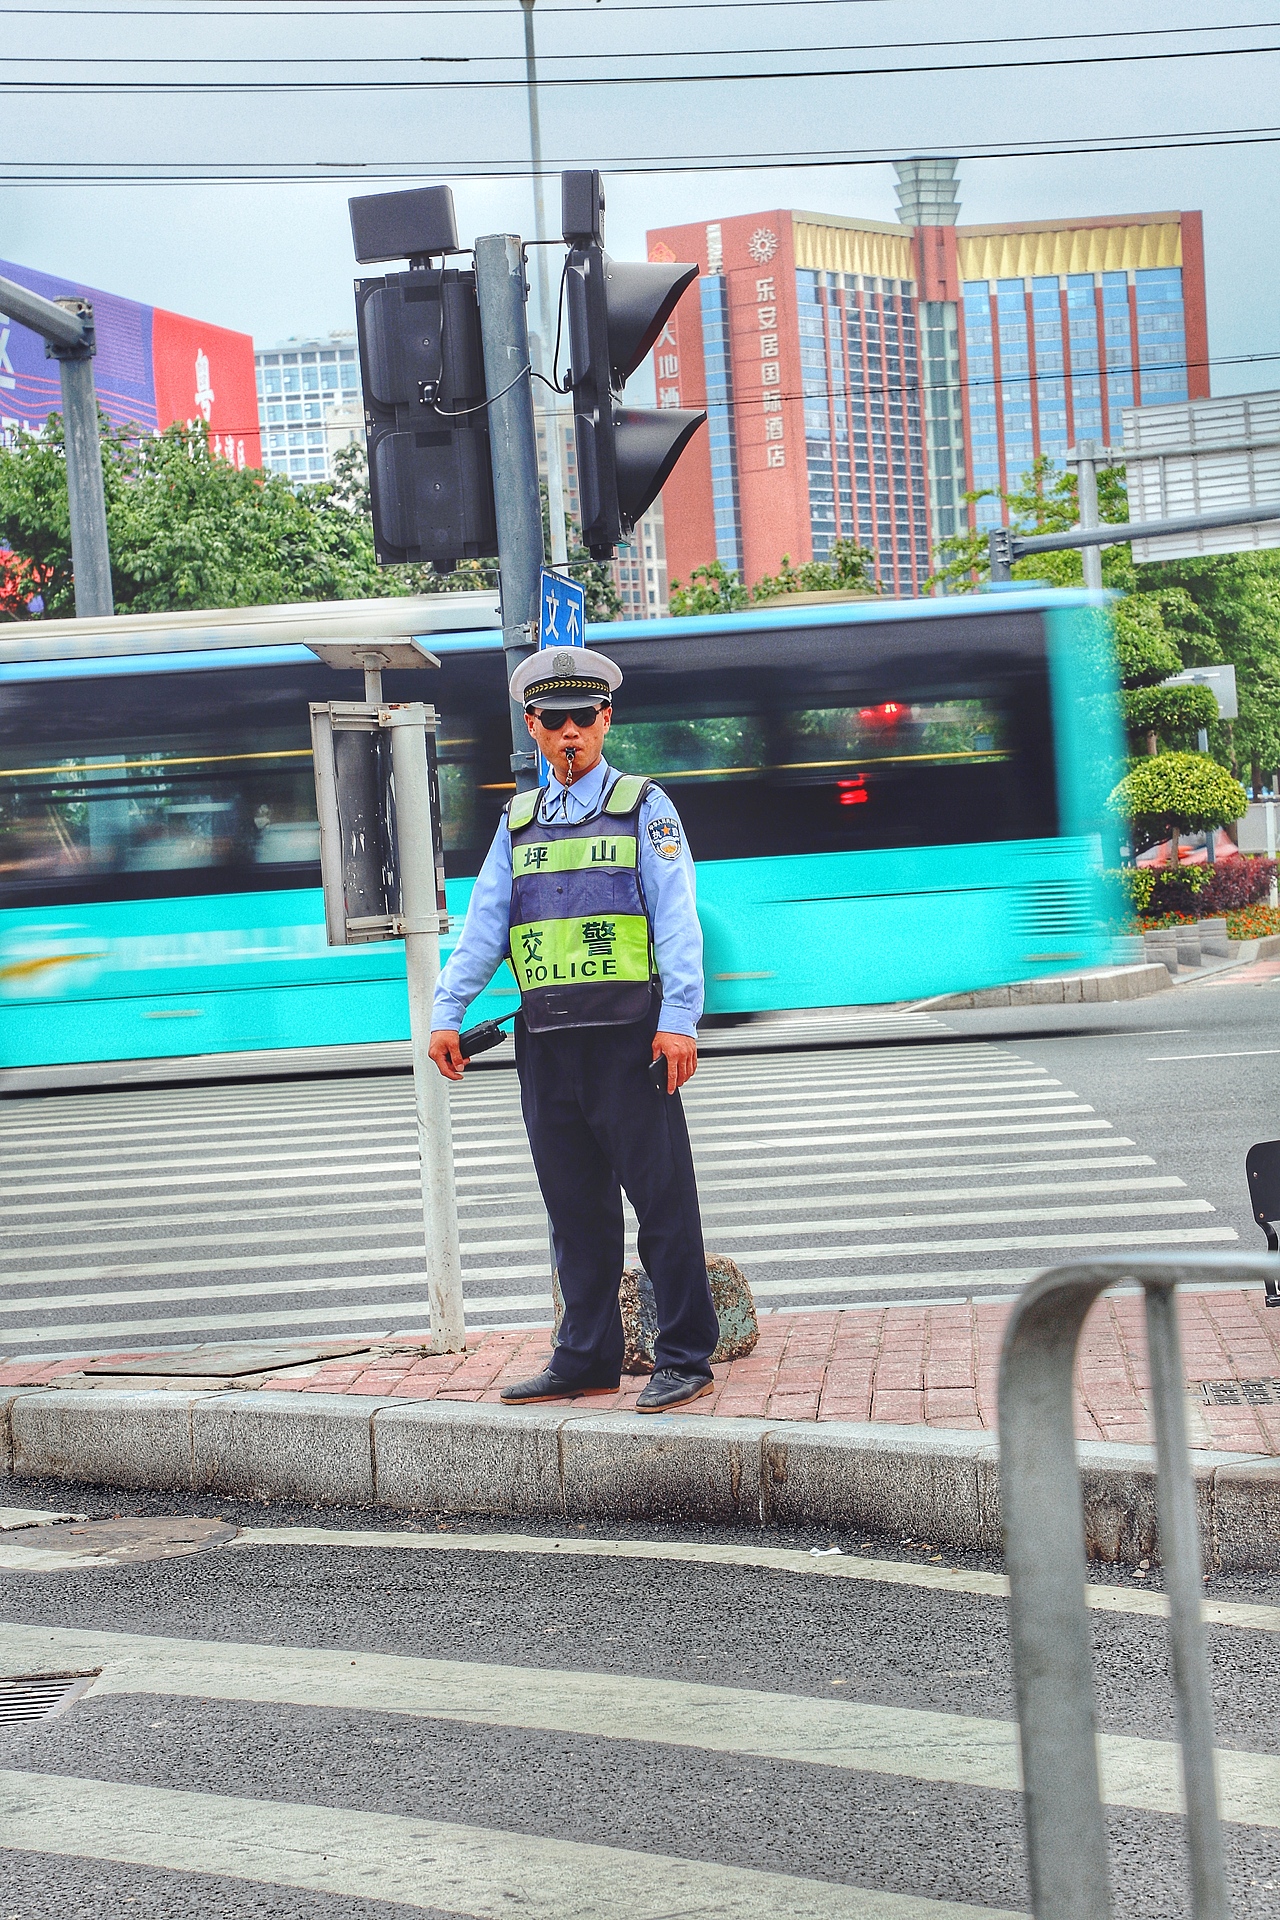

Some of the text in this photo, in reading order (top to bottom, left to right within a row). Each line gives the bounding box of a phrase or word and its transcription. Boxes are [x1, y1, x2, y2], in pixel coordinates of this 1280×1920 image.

[755, 276, 786, 469] 乐安居国际酒店
[523, 840, 617, 869] 坪山
[521, 920, 617, 964] 交警
[525, 959, 618, 984] POLICE
